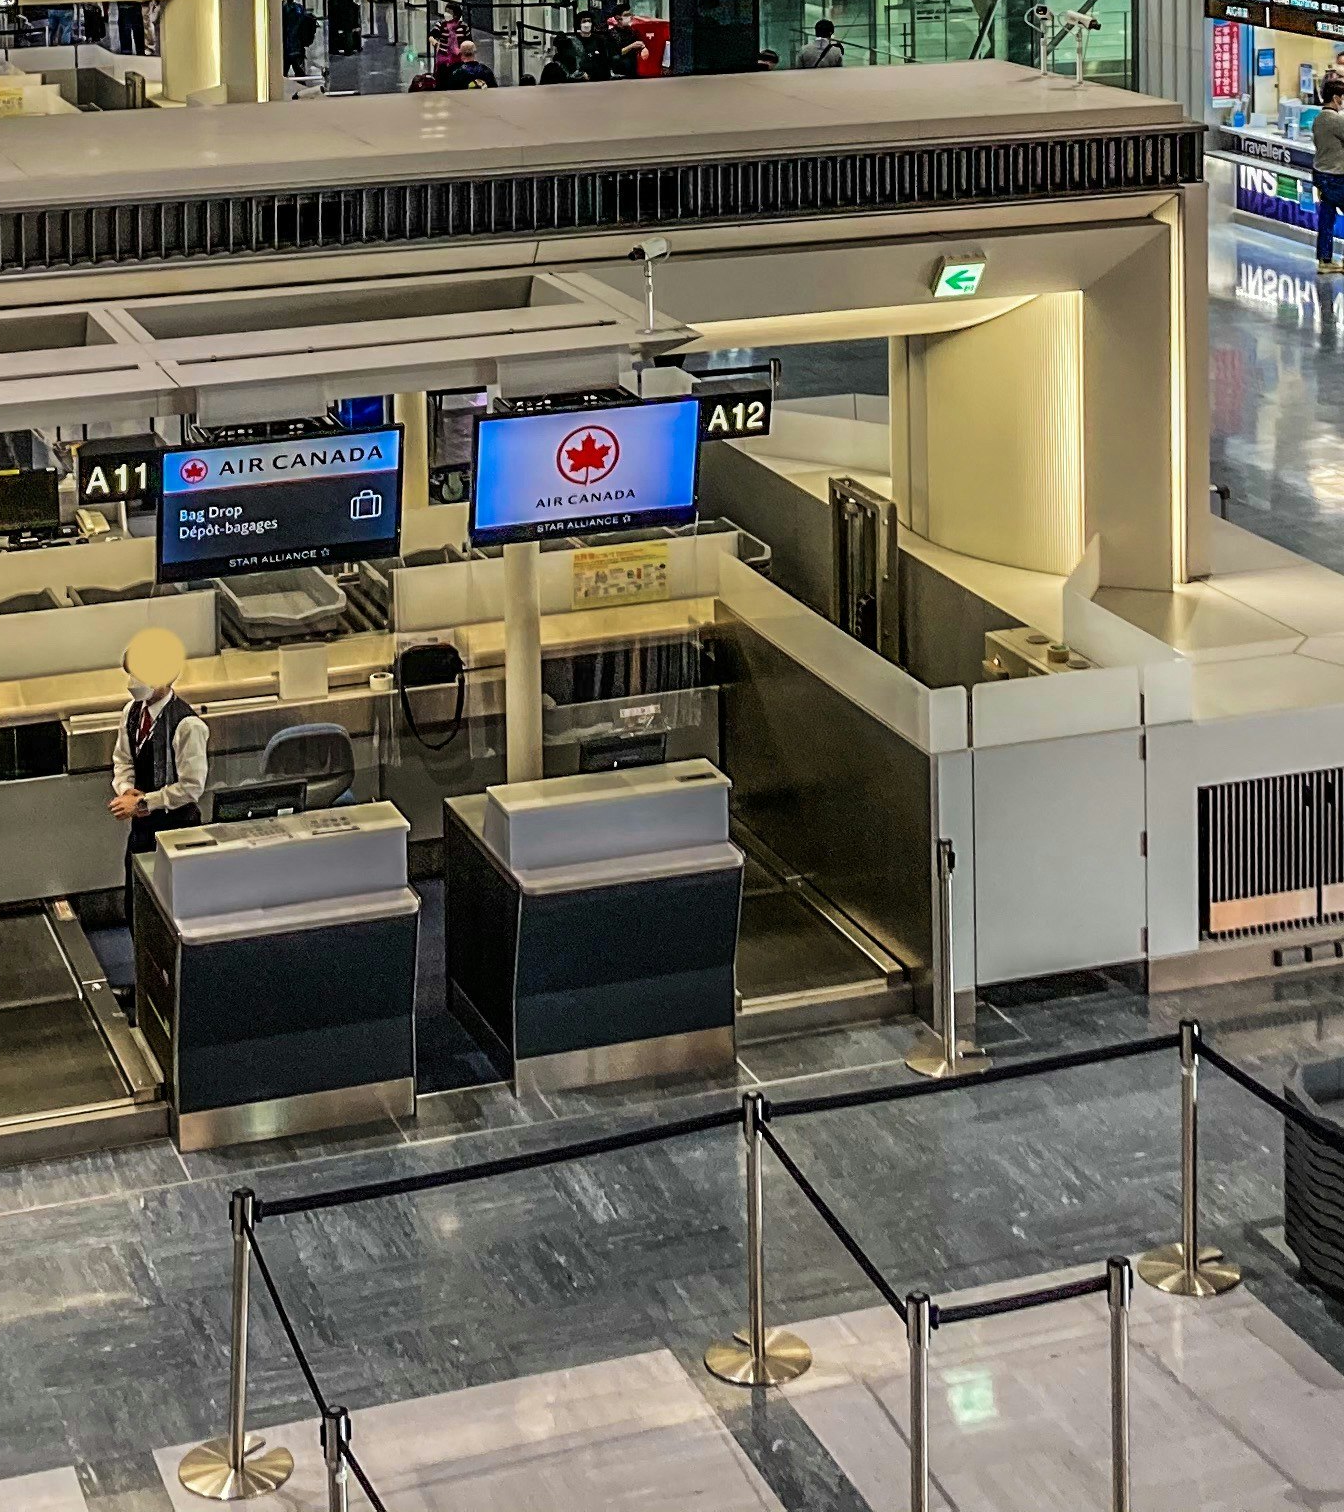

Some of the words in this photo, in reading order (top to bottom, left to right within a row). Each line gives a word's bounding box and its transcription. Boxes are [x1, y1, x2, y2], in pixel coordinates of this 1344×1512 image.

[1241, 137, 1292, 164] Traveller's
[707, 401, 766, 433] A12
[219, 457, 265, 476] AIR
[273, 445, 383, 470] CANADA
[85, 462, 148, 495] A11
[535, 496, 563, 509] AIR
[567, 488, 636, 506] CANADA
[179, 507, 205, 524] Bag
[208, 505, 243, 522] Drop
[537, 522, 564, 533] STAR
[567, 515, 619, 530] ALLIANCE
[179, 517, 278, 540] Dépôt-bagages
[229, 556, 258, 569] STAR
[261, 548, 317, 565] ALLIANCE
